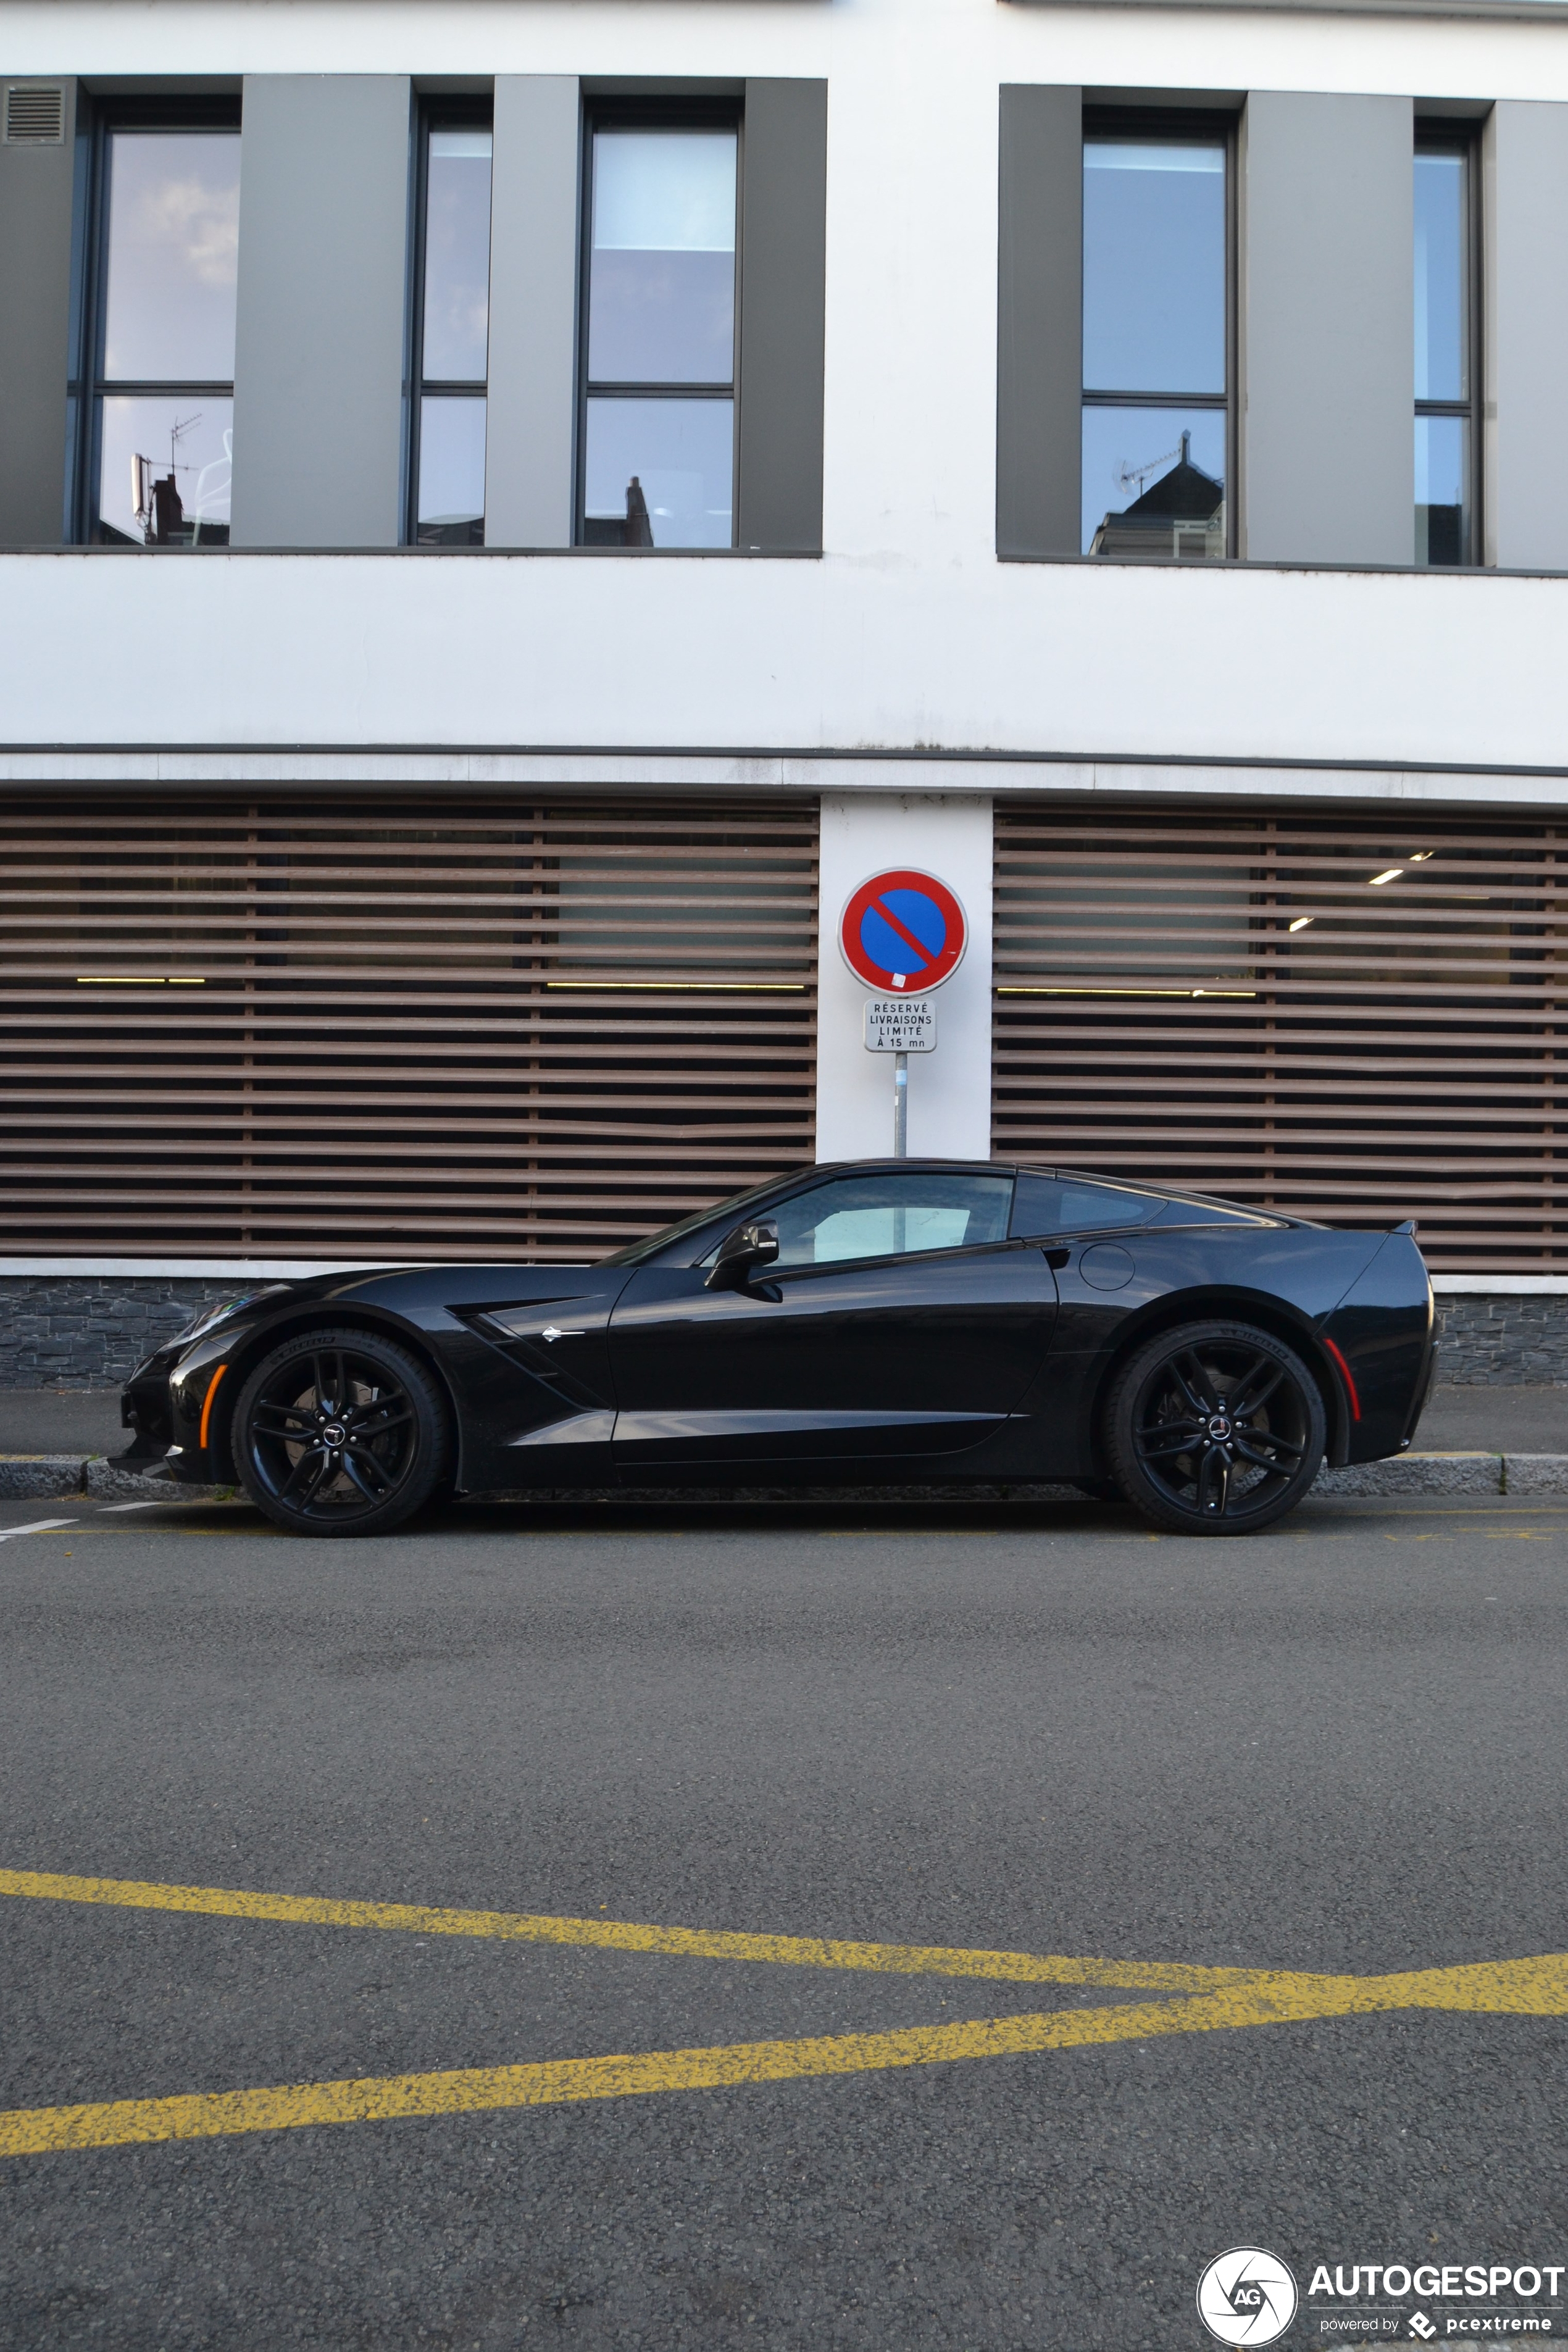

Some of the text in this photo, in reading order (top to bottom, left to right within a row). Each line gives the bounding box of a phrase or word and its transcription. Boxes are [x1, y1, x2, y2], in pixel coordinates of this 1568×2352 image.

[874, 1002, 927, 1013] RÉSERVÉ
[870, 1015, 932, 1025] LIVRAISONS
[880, 1025, 922, 1036] LIMITÉ
[877, 1036, 884, 1047] À
[890, 1038, 902, 1047] 15
